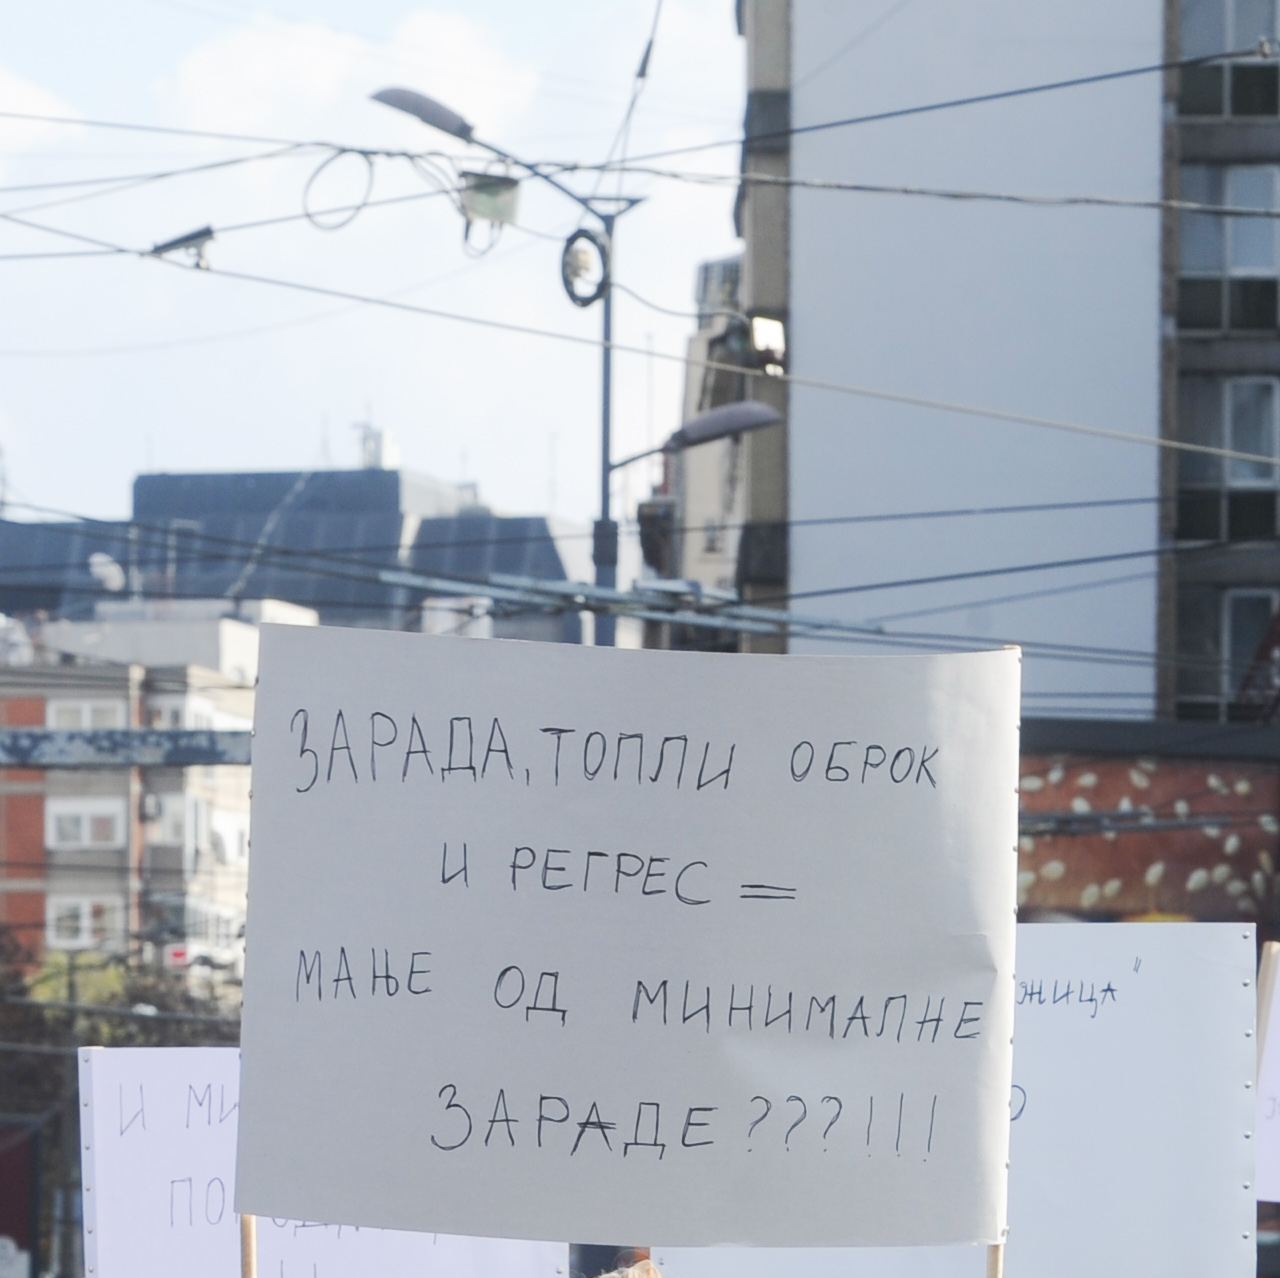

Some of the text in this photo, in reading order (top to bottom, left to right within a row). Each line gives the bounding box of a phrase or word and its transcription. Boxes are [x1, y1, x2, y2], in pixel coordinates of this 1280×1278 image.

[790, 740, 940, 789] ОБРОК
[440, 842, 469, 888] И
[509, 846, 711, 906] РЕГРЕС
[295, 946, 984, 1044] МАЊЕ ОД МИНИМАЛНЕ
[119, 1083, 147, 1138] И
